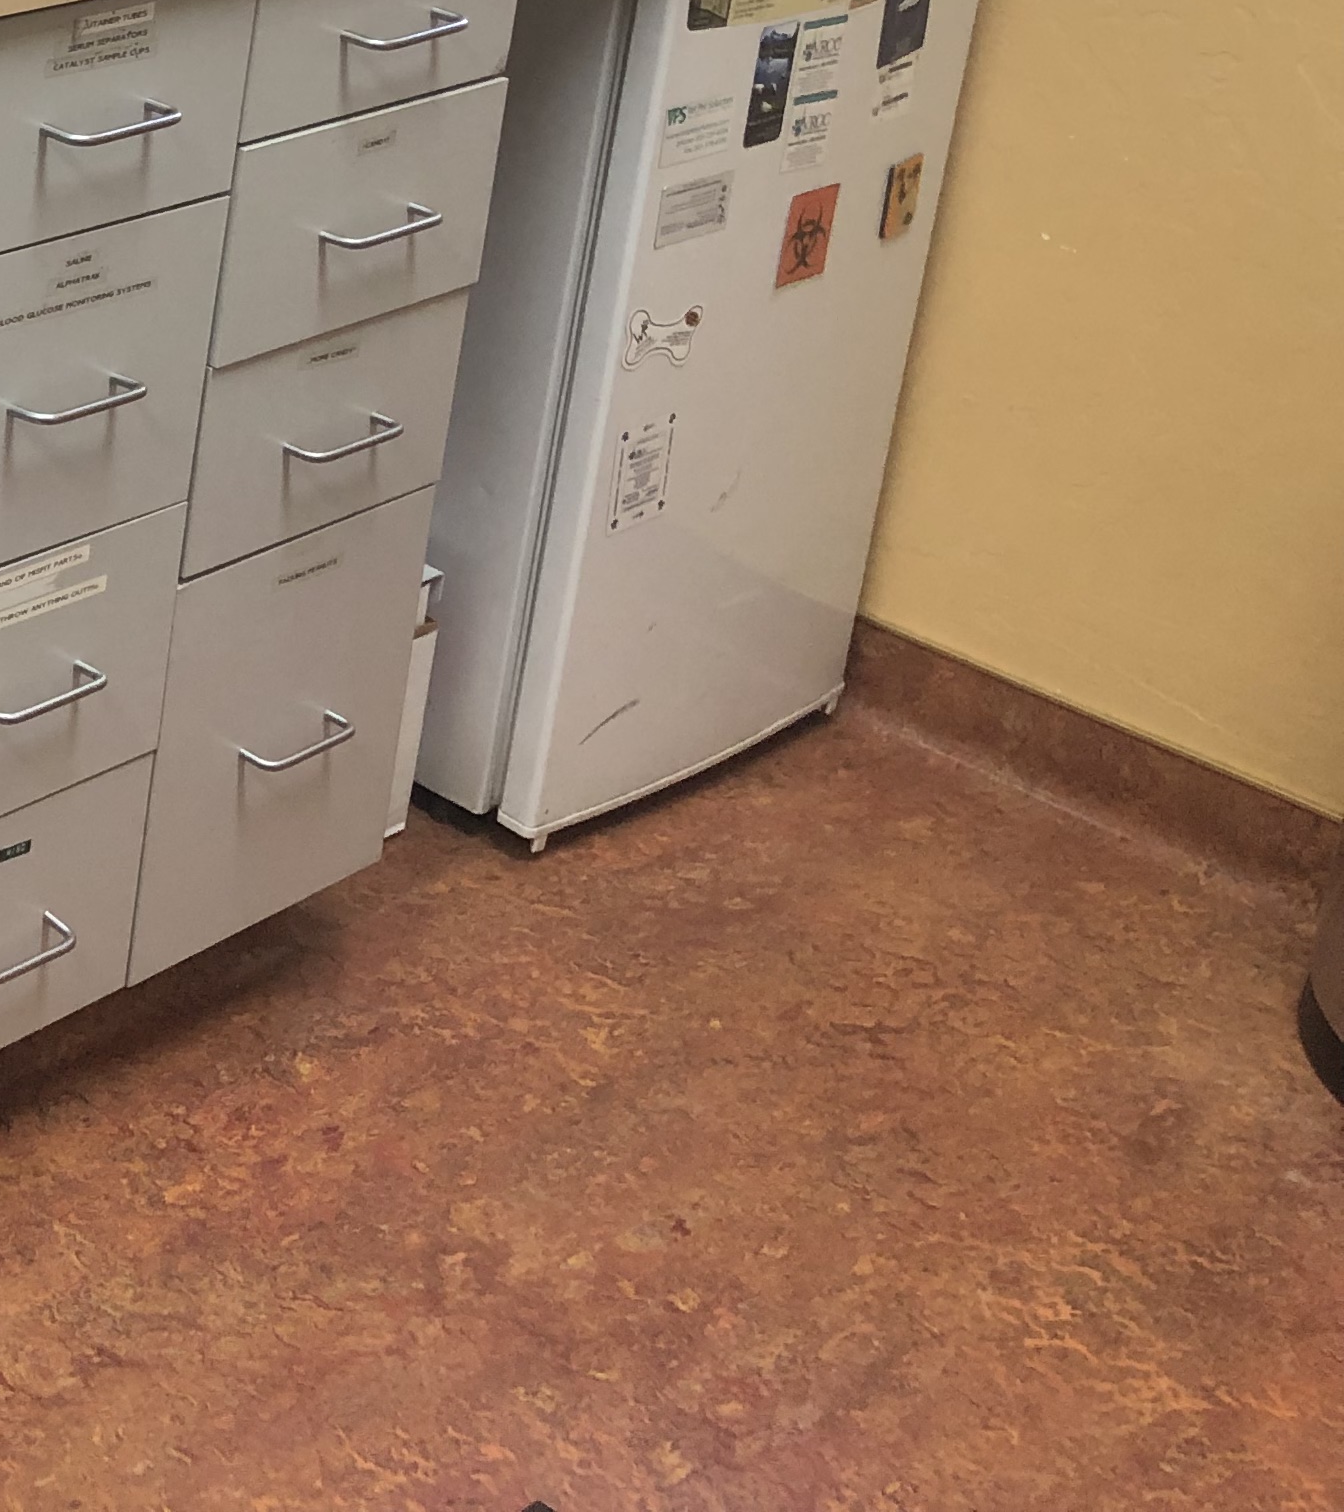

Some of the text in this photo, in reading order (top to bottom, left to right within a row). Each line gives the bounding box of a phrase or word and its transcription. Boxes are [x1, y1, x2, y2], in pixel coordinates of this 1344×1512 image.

[123, 9, 148, 22] TUBES
[68, 30, 148, 53] SERUM SEPARATORS
[54, 46, 150, 72] CATALYST SAMPLE CUPS
[66, 254, 92, 268] SALINE
[27, 304, 64, 320] GLUCOSE
[66, 291, 114, 309] MONITORING
[116, 281, 152, 296] SYSTEMS
[14, 573, 26, 582] OF
[28, 564, 51, 578] MISFIT
[0, 608, 29, 623] THROW
[32, 594, 69, 612] ANYTHING
